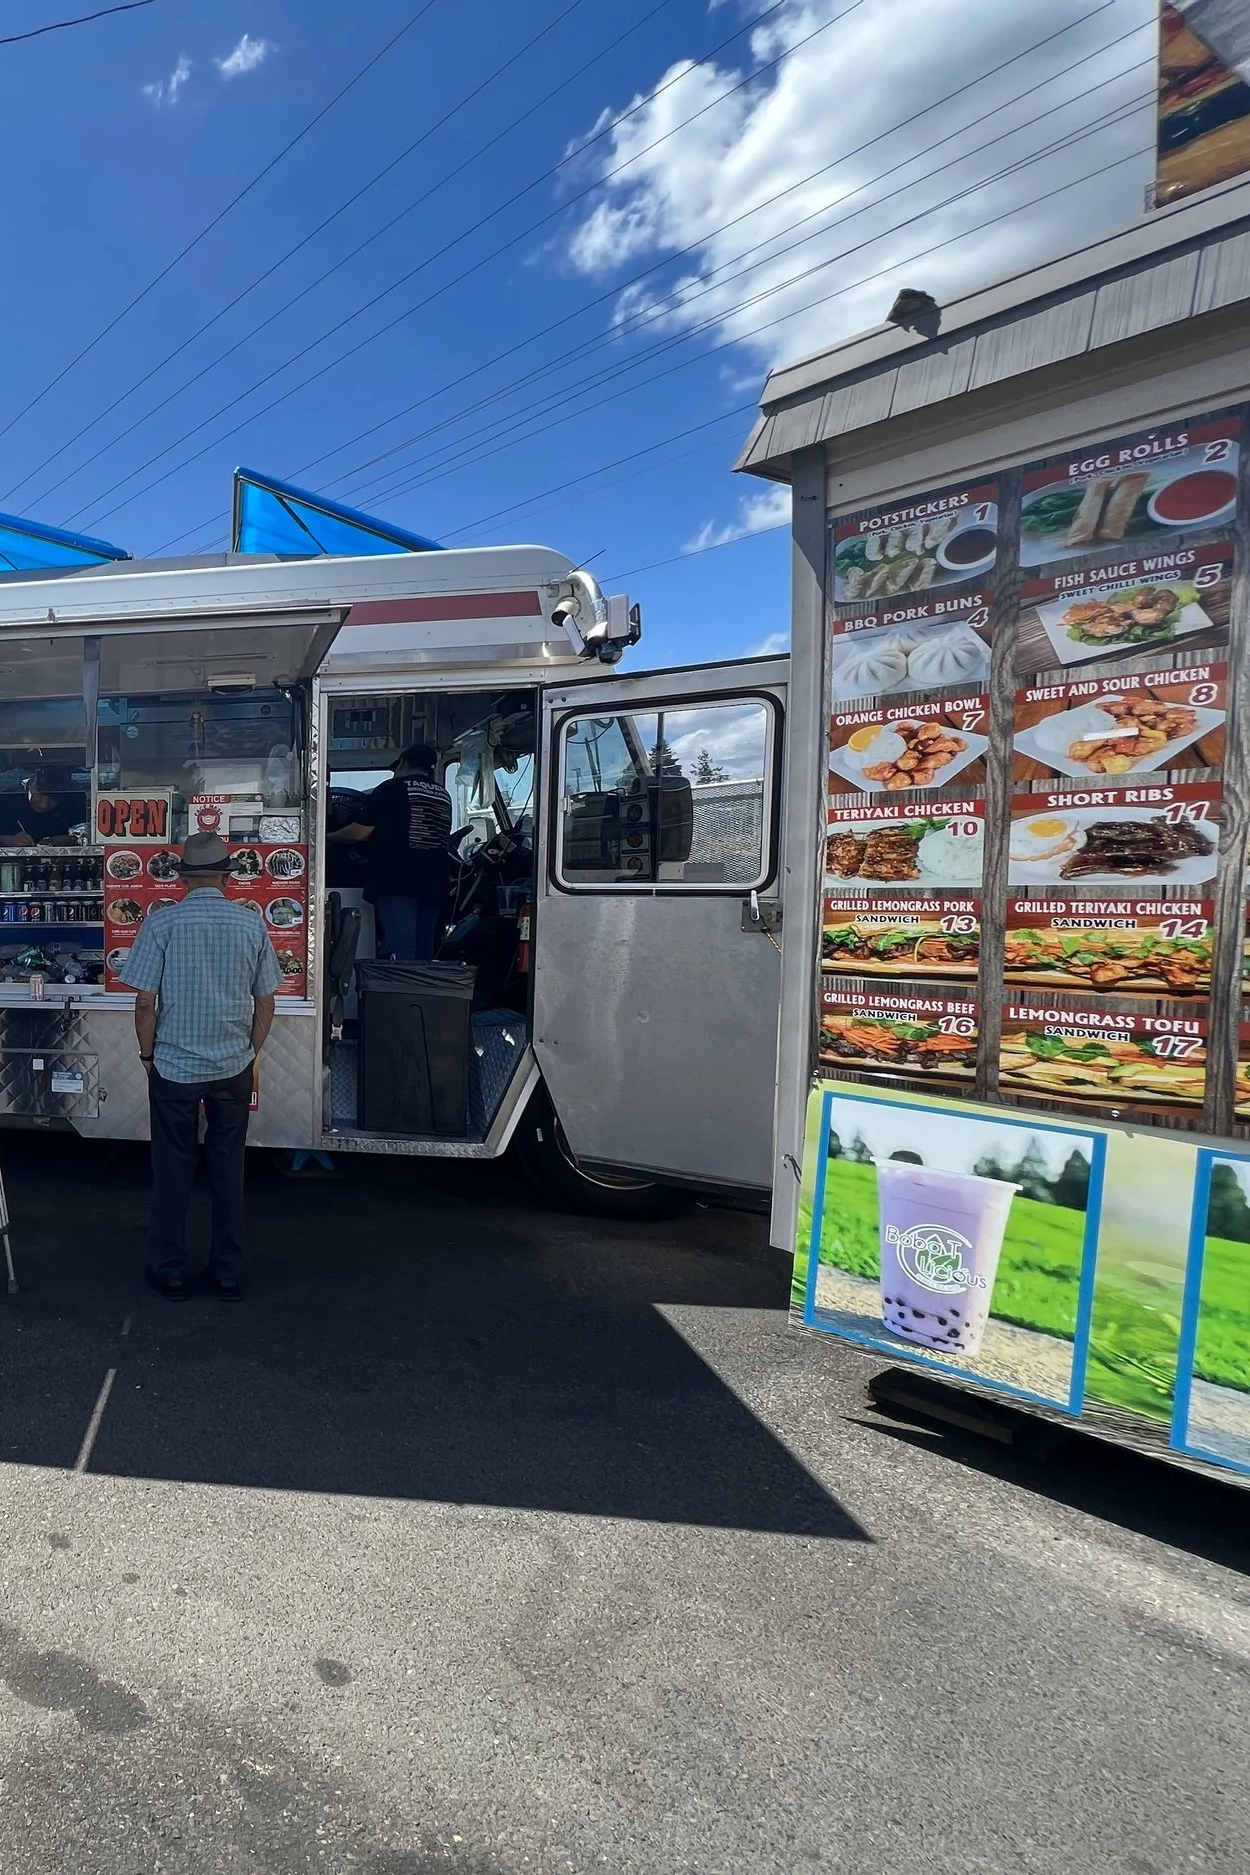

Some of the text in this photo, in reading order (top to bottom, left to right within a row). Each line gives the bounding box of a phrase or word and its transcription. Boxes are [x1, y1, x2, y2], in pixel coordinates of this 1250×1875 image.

[1068, 433, 1188, 476] EGG ROLLS
[1203, 438, 1233, 464] 2
[859, 493, 969, 532] POTSTICKERS
[973, 501, 992, 524] 1
[1054, 550, 1196, 590] FISH SAUCE WINGS
[1194, 562, 1223, 588] 5
[1059, 570, 1181, 601] SWEET CHILLI WINGS
[844, 595, 983, 633] BBQ PORK BUNS
[967, 607, 989, 629] 4
[1025, 666, 1211, 703] SWEET AND SOUR CHICKEN
[1189, 682, 1218, 706] 8
[835, 697, 983, 728] ORANGE CHICKEN BOWL
[962, 711, 986, 732] 7
[192, 795, 226, 804] NOTICE
[1047, 787, 1174, 808] SHORT RIBS
[97, 799, 168, 837] OPEN
[835, 801, 975, 821] TERIYAKI CHICKEN
[1163, 801, 1210, 825] 11
[947, 820, 979, 838] 10
[830, 899, 975, 913] GRILLED LEMONGRASS PORK
[1014, 901, 1202, 917] GRILLED TERIYAKI CHICKEN
[855, 913, 920, 925] SANDWICH
[940, 915, 976, 935] 13
[1050, 916, 1137, 931] SANDWICH
[1159, 918, 1208, 940] 14
[823, 991, 976, 1016] GRILLED LEMONGRASS BEEF
[852, 1008, 918, 1023] SANDWICH
[938, 1016, 976, 1037] 16
[1009, 1006, 1201, 1034] LEMONGRASS TOFU
[1044, 1025, 1130, 1043] SANDWICH
[1151, 1034, 1203, 1058] 17
[886, 1225, 962, 1259] Boba T
